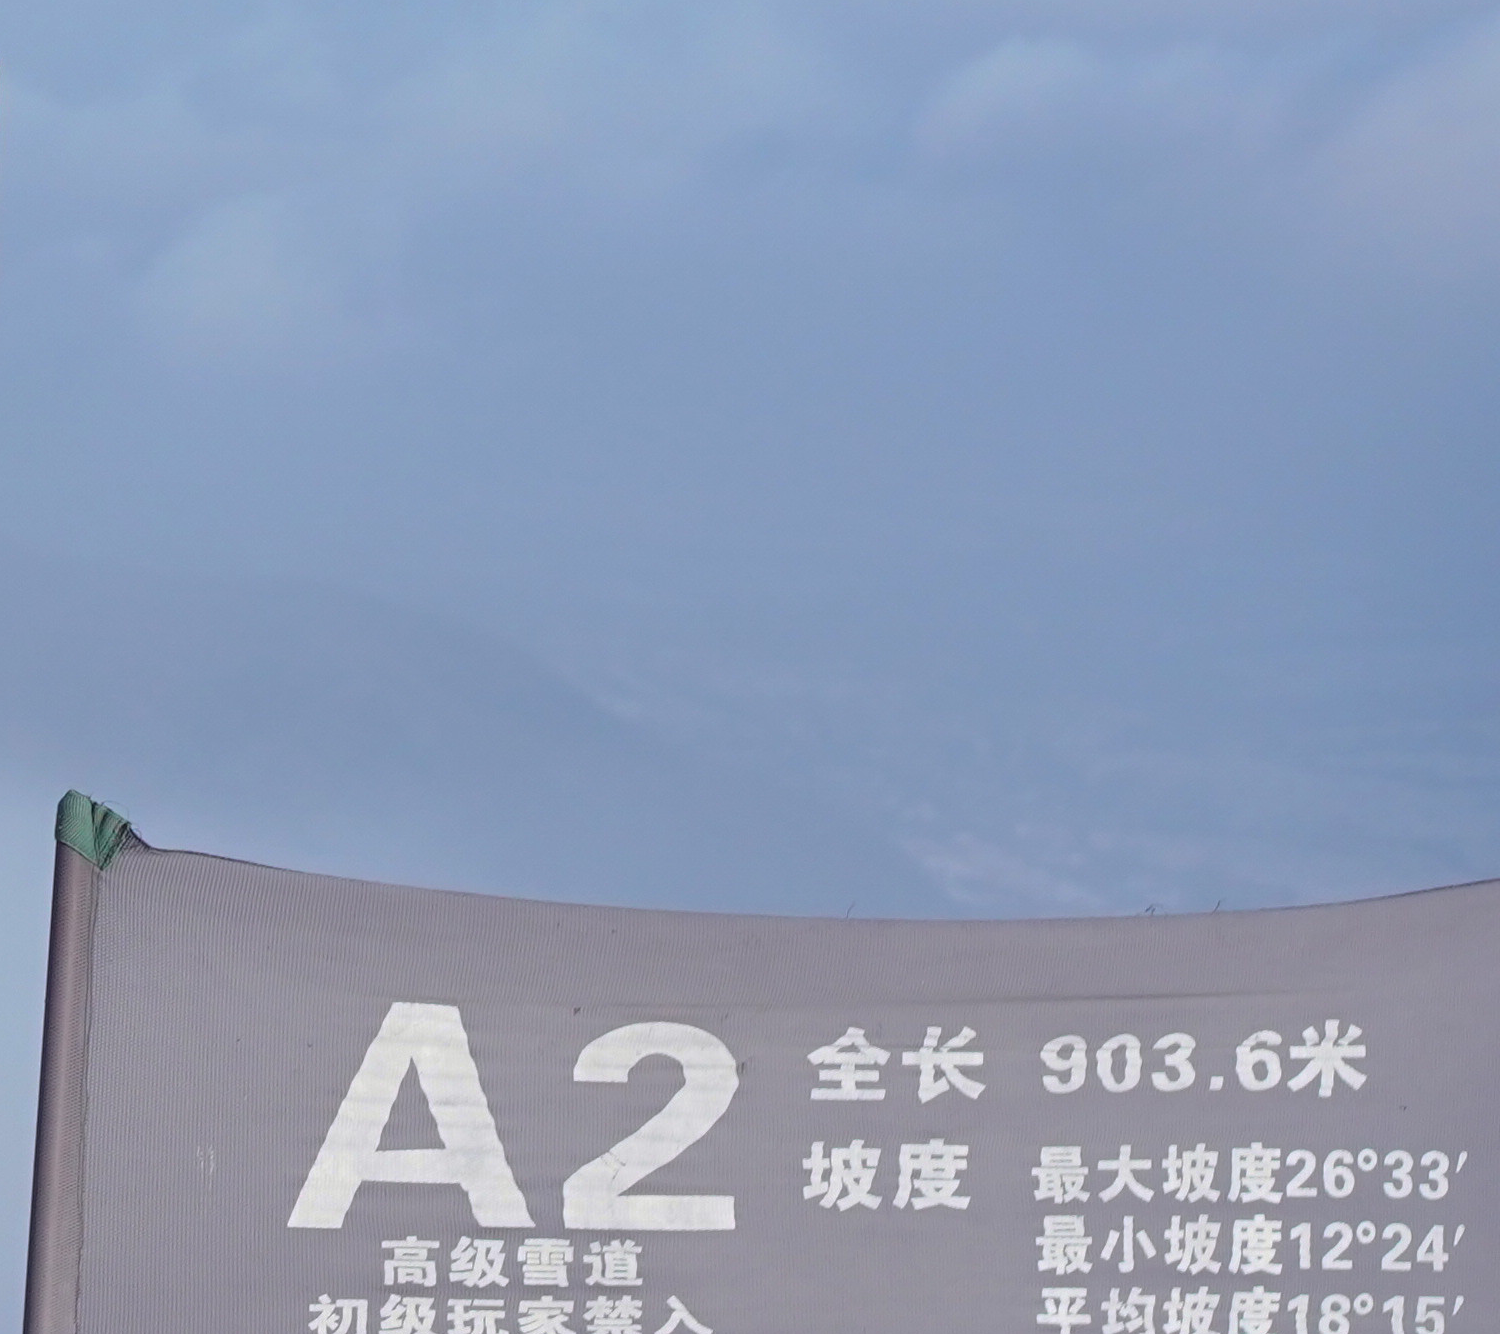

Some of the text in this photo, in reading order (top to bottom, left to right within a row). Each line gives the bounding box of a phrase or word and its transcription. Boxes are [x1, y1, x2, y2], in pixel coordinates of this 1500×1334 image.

[807, 1018, 1367, 1102] 全长 903.6米
[287, 1002, 739, 1231] A2
[803, 1139, 971, 1211] 坡度
[381, 1236, 643, 1287] 高级雪道
